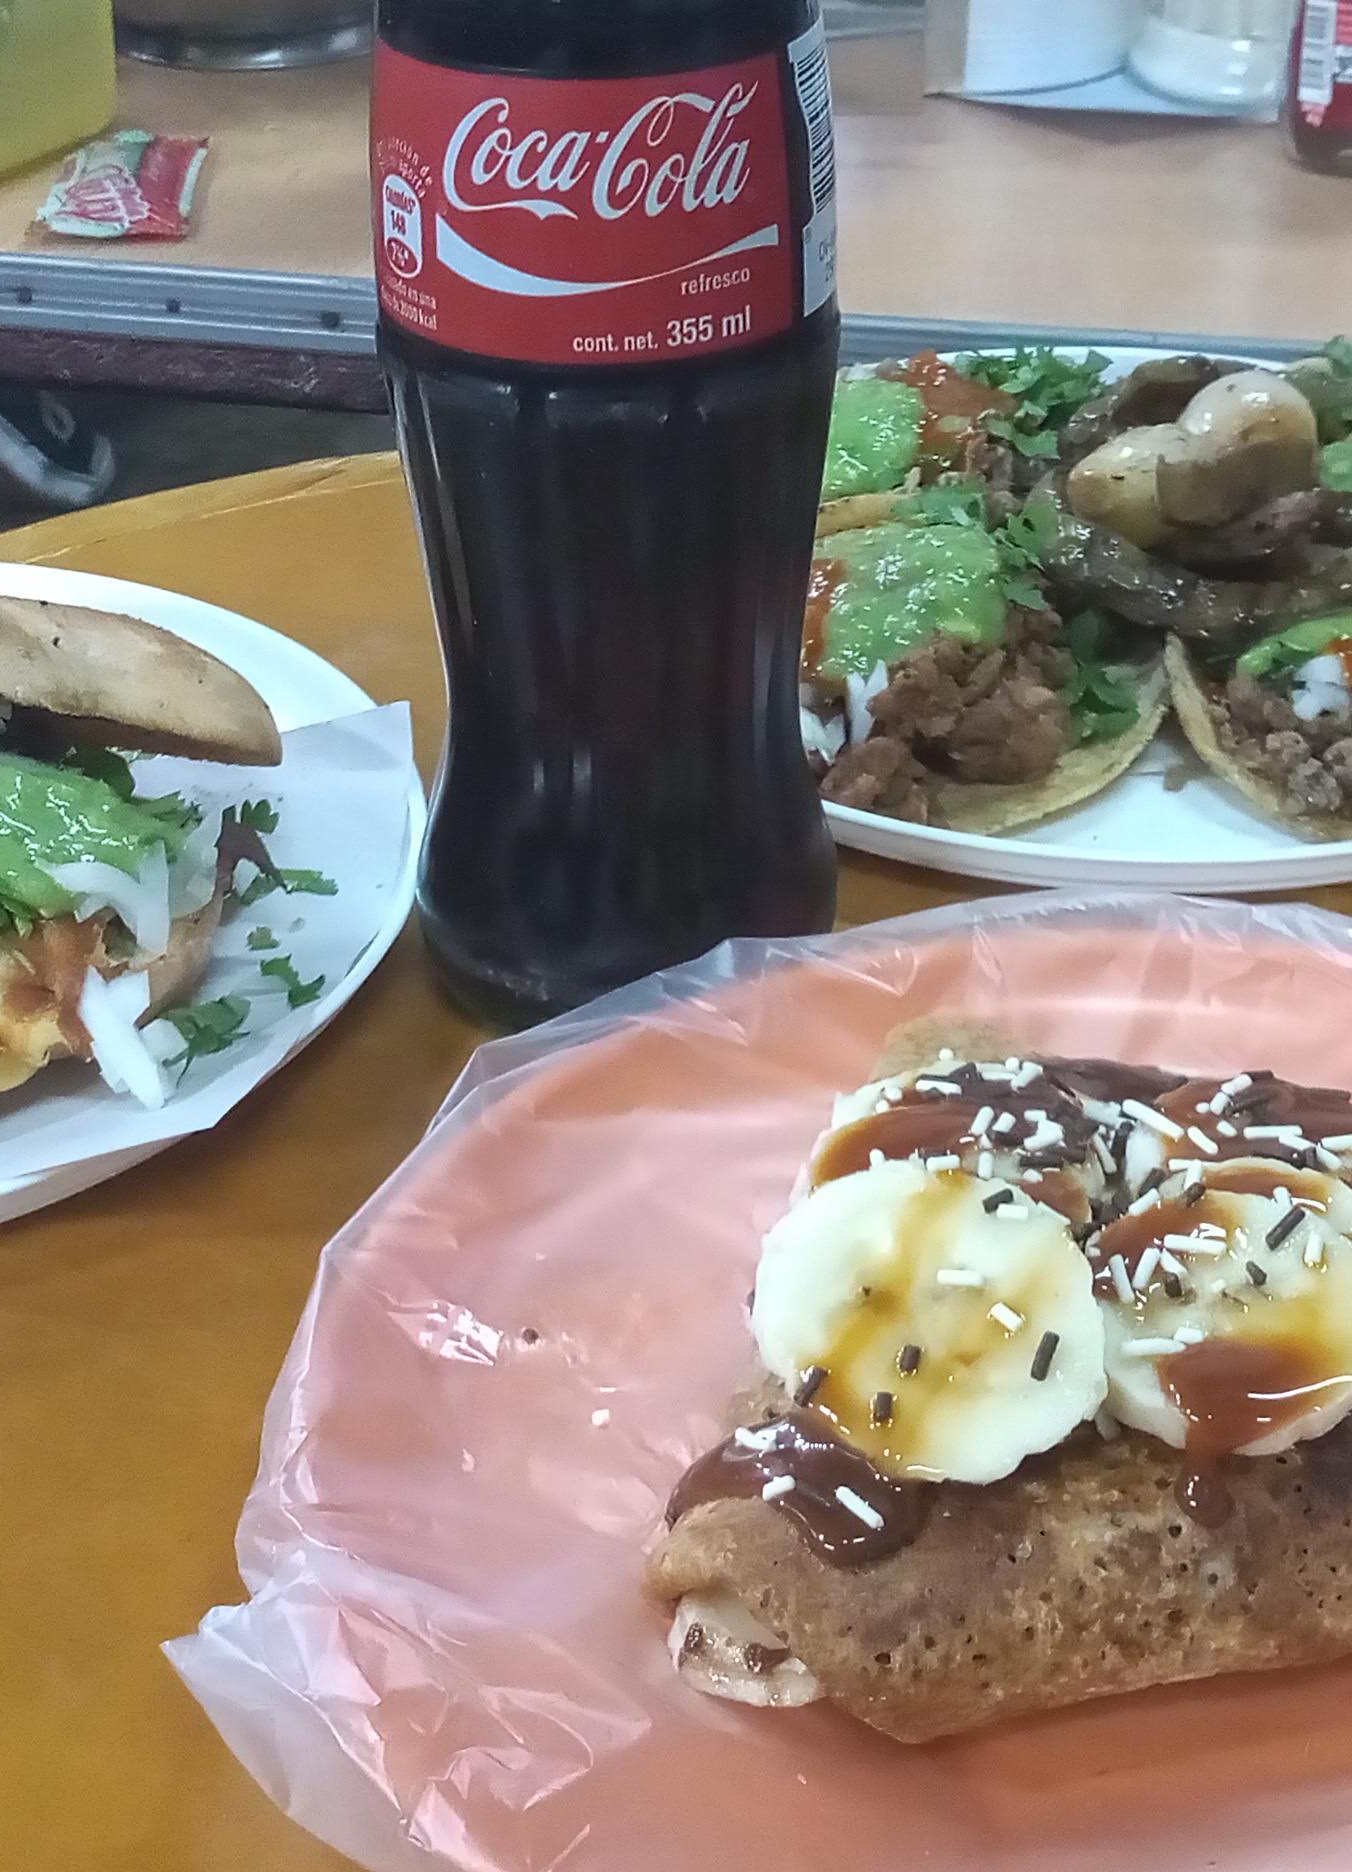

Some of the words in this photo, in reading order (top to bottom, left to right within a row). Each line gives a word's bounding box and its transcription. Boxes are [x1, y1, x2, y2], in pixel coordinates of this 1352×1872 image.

[443, 80, 759, 220] Coca-Cola
[681, 267, 751, 295] refresco
[419, 308, 438, 330] kcal
[572, 332, 620, 352] cont.
[624, 331, 659, 351] net.
[666, 314, 714, 347] 355
[722, 304, 751, 337] ml
